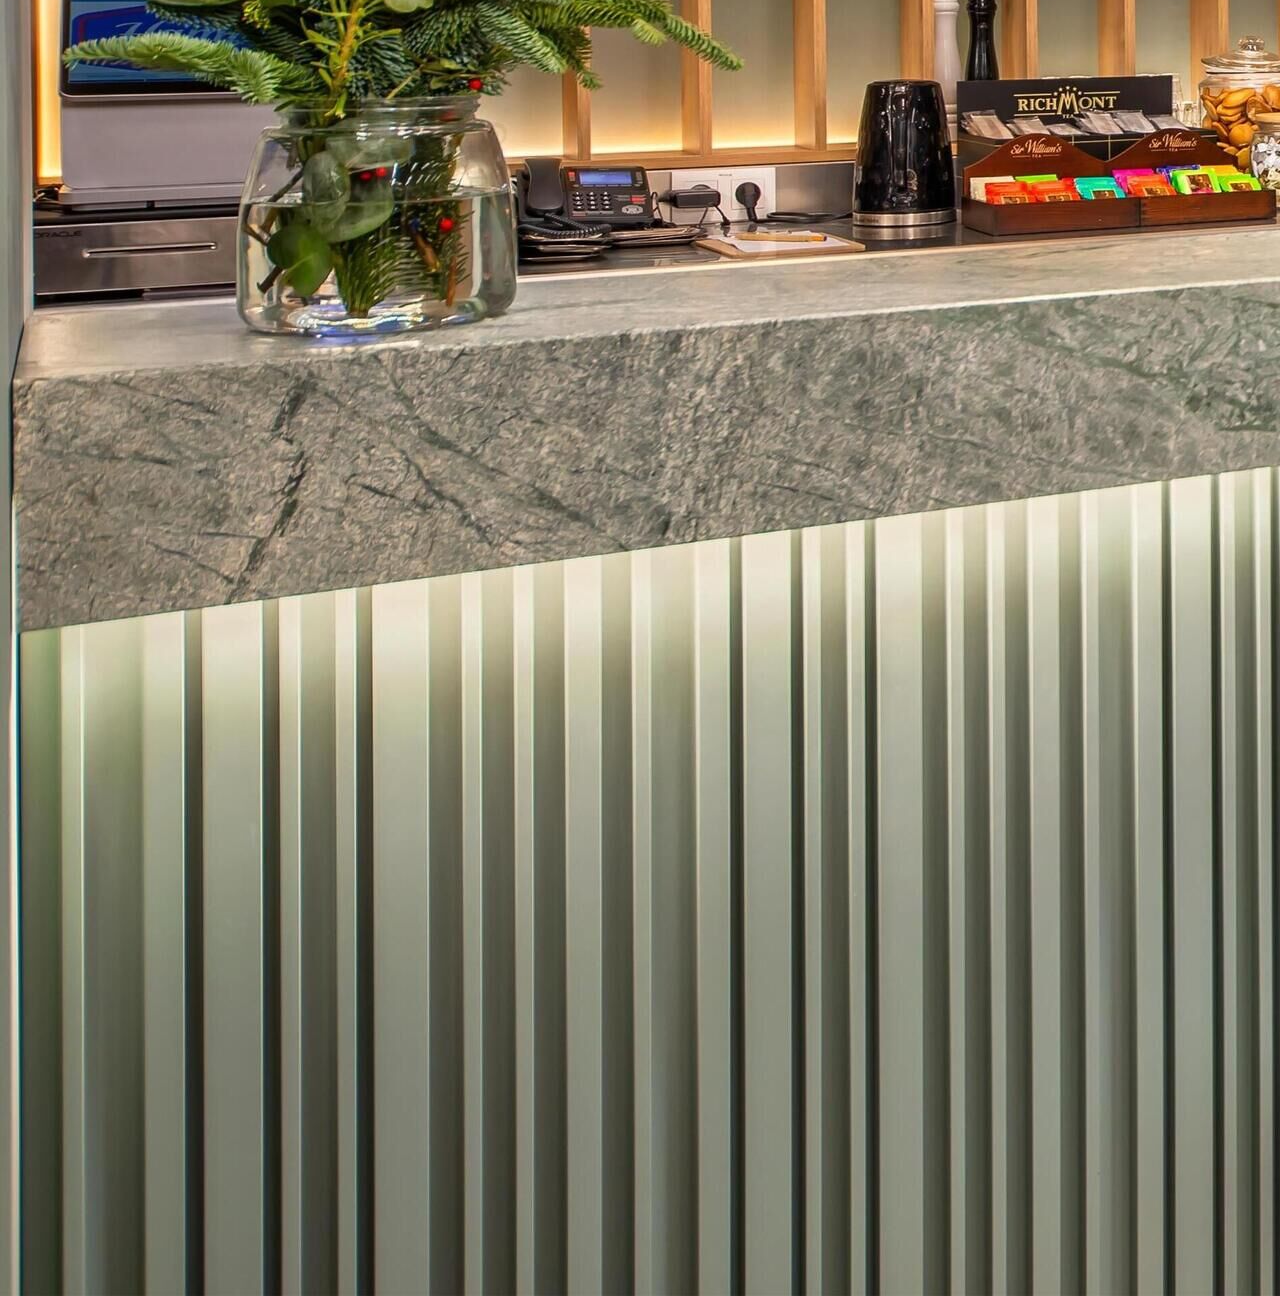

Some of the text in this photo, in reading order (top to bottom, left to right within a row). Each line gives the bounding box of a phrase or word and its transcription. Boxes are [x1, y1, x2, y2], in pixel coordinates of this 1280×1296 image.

[1017, 90, 1117, 115] RICHMONT
[1010, 137, 1063, 154] Sir William's
[1149, 132, 1198, 149] Sir William's
